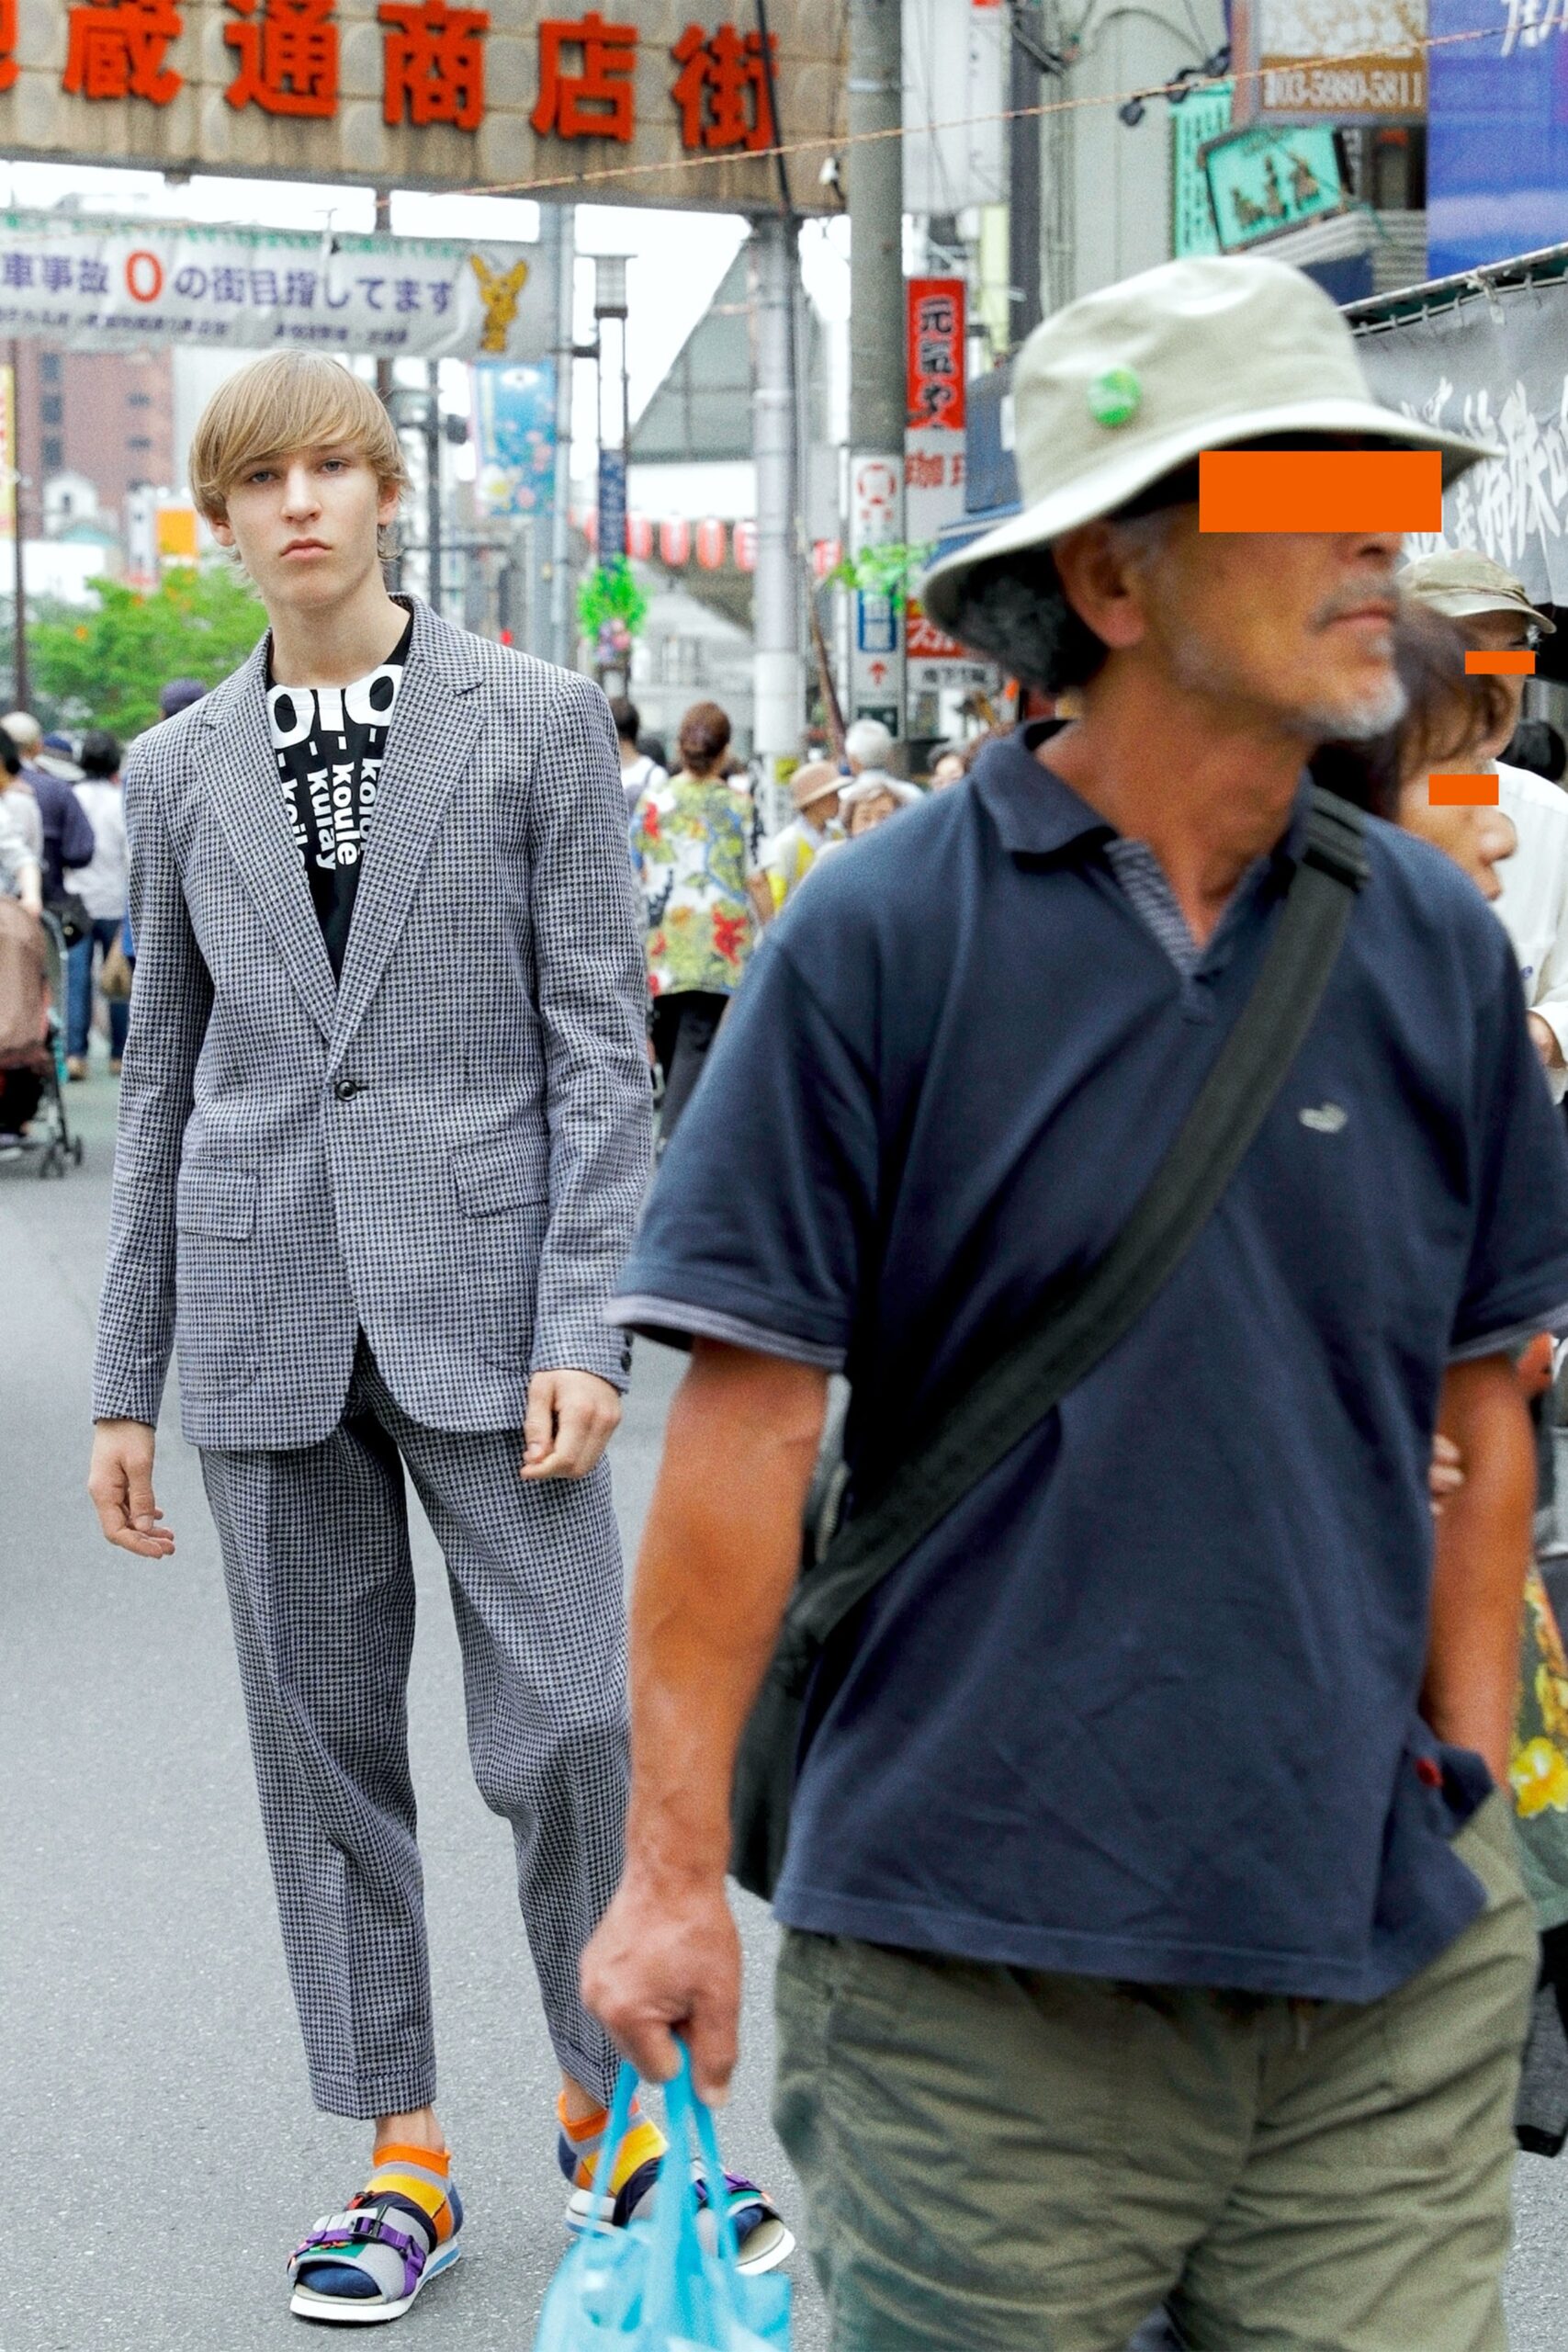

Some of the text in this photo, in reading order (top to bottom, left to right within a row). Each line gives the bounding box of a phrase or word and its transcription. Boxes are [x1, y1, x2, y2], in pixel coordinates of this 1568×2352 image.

[0, 0, 779, 150] 蔵通商店街
[920, 299, 953, 429] 元気や
[306, 768, 336, 870] kulay
